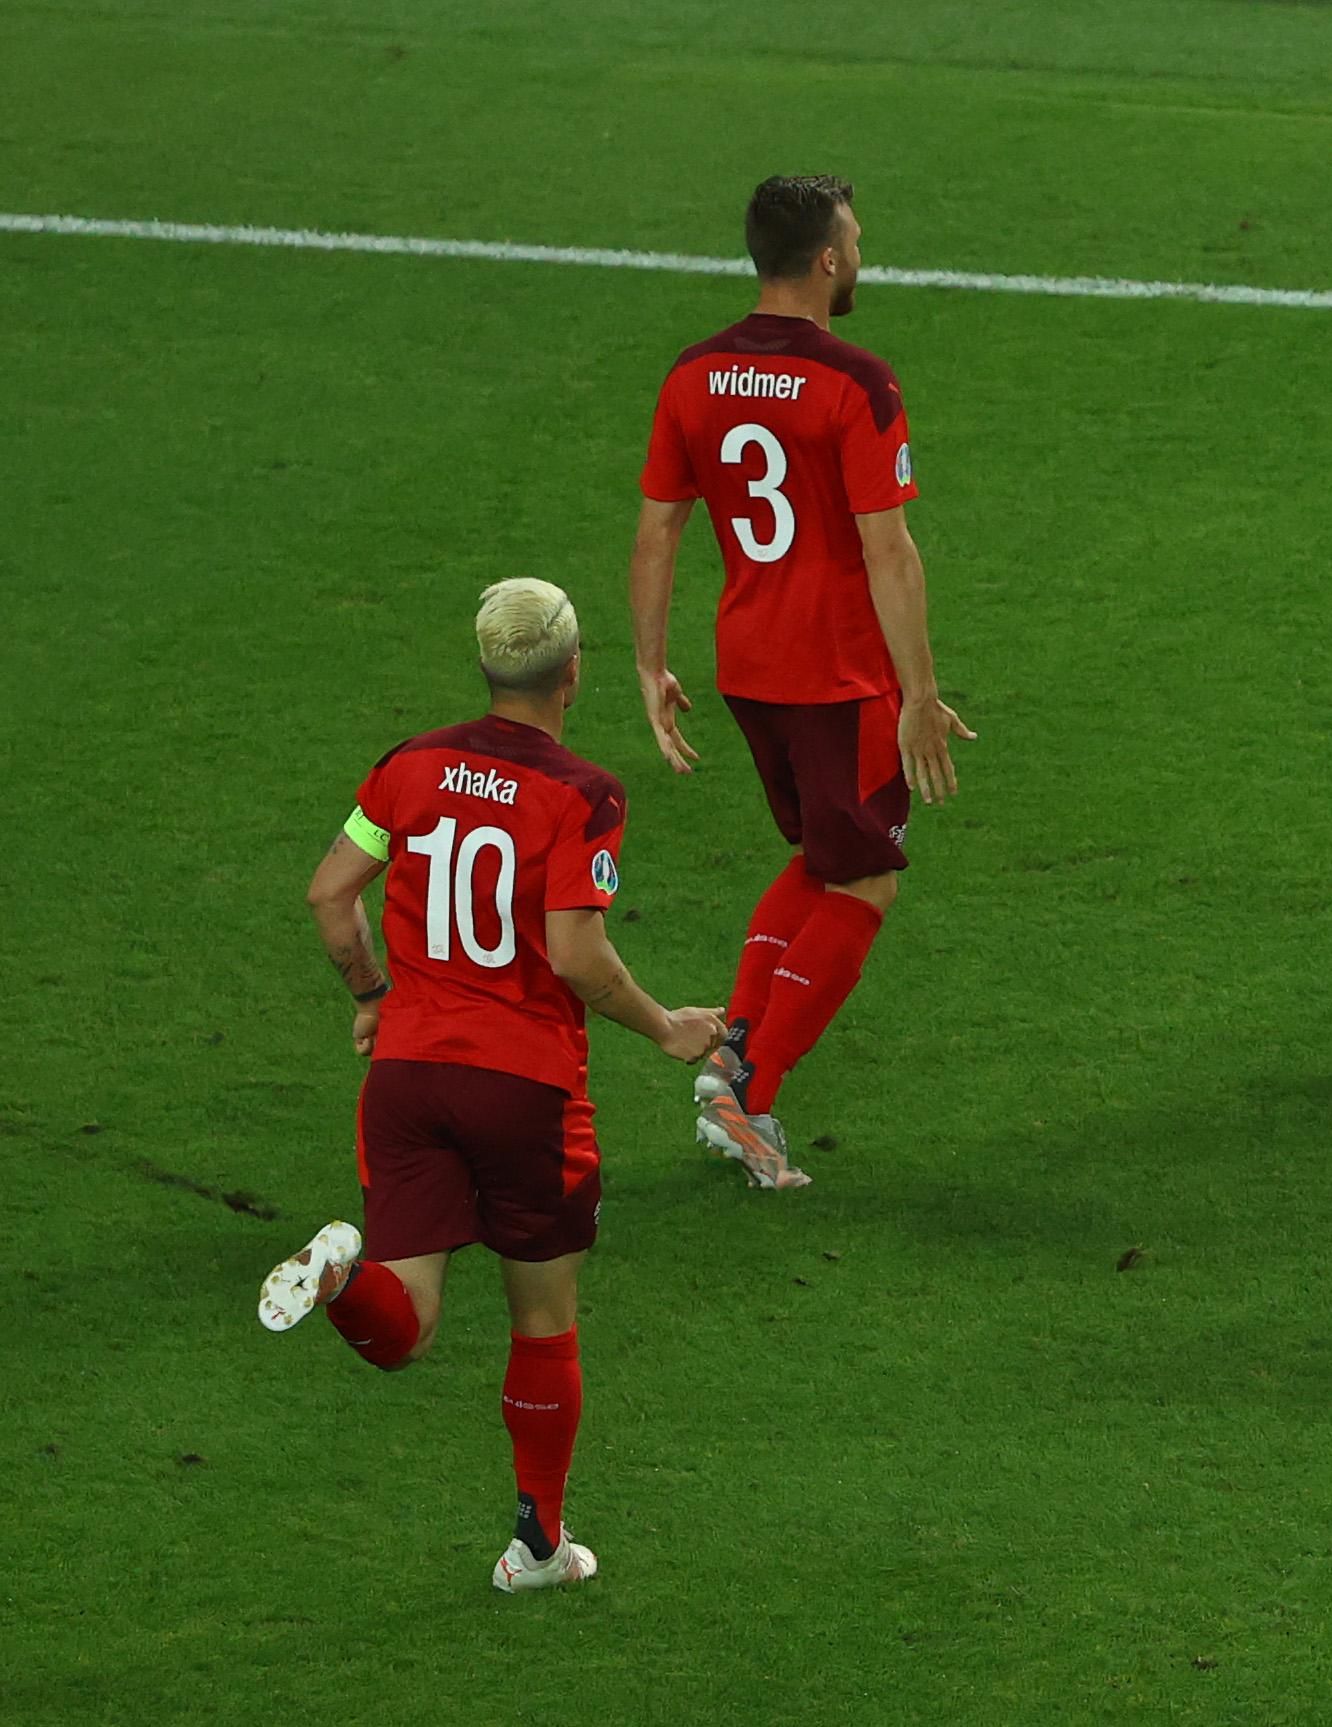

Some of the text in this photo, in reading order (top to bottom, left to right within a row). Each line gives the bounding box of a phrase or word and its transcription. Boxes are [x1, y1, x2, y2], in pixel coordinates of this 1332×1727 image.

[709, 364, 806, 400] widmer
[720, 423, 795, 563] 3
[438, 762, 518, 806] xhaka
[407, 815, 516, 968] 10
